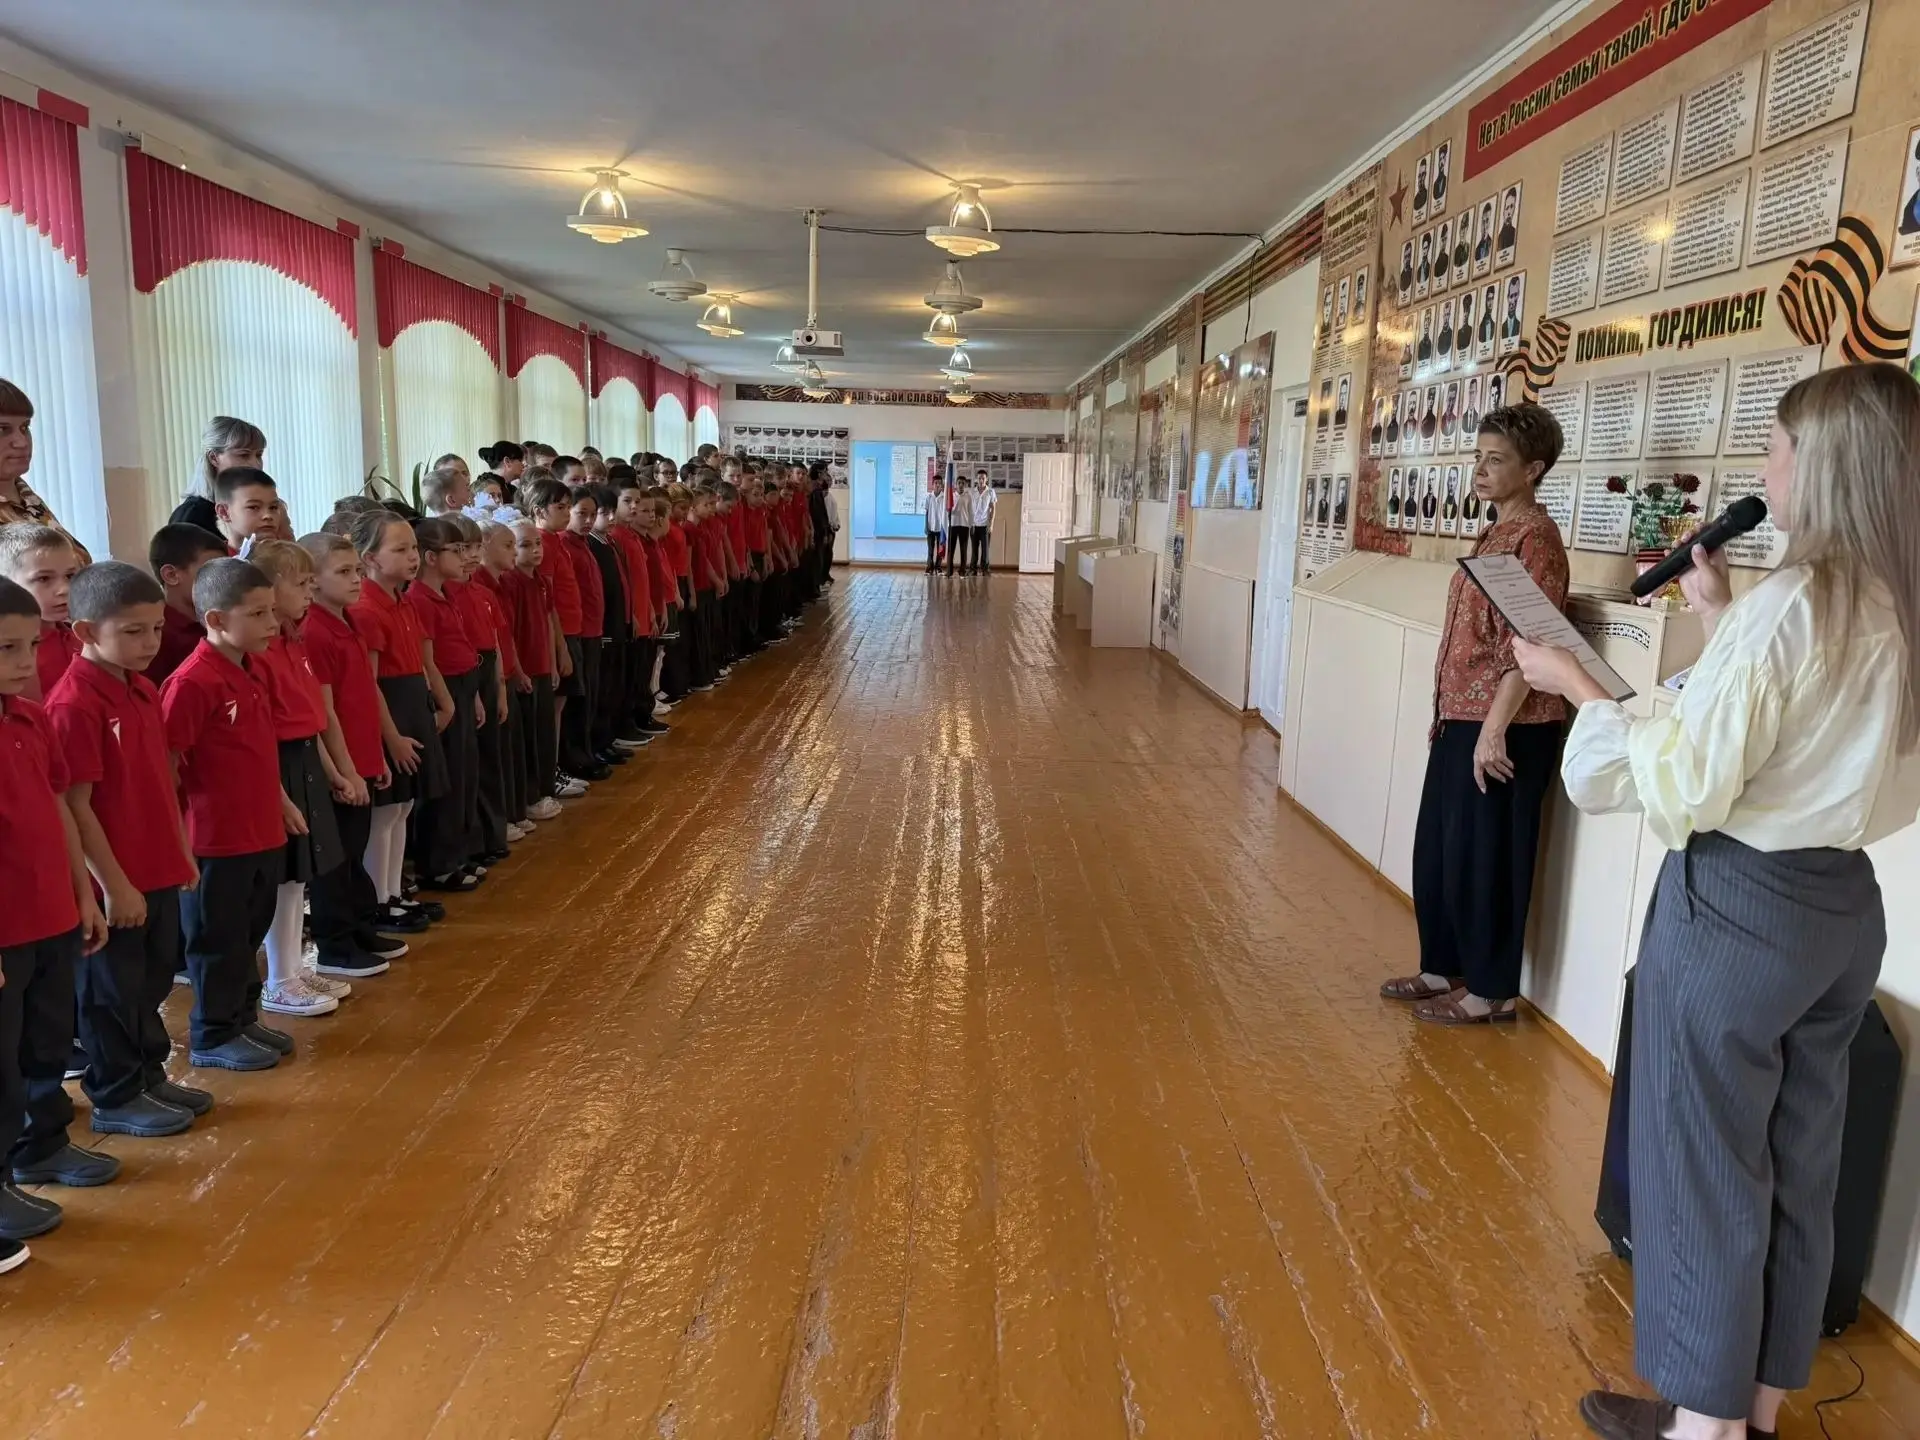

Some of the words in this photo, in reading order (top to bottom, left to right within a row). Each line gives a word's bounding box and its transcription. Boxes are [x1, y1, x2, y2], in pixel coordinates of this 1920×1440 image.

[1478, 118, 1500, 150] Нет
[1507, 82, 1553, 133] России
[1554, 49, 1601, 101] семьи
[1603, 9, 1655, 71] такой,
[1658, 0, 1692, 37] где
[1647, 288, 1767, 350] ГОРДИМСЯ!
